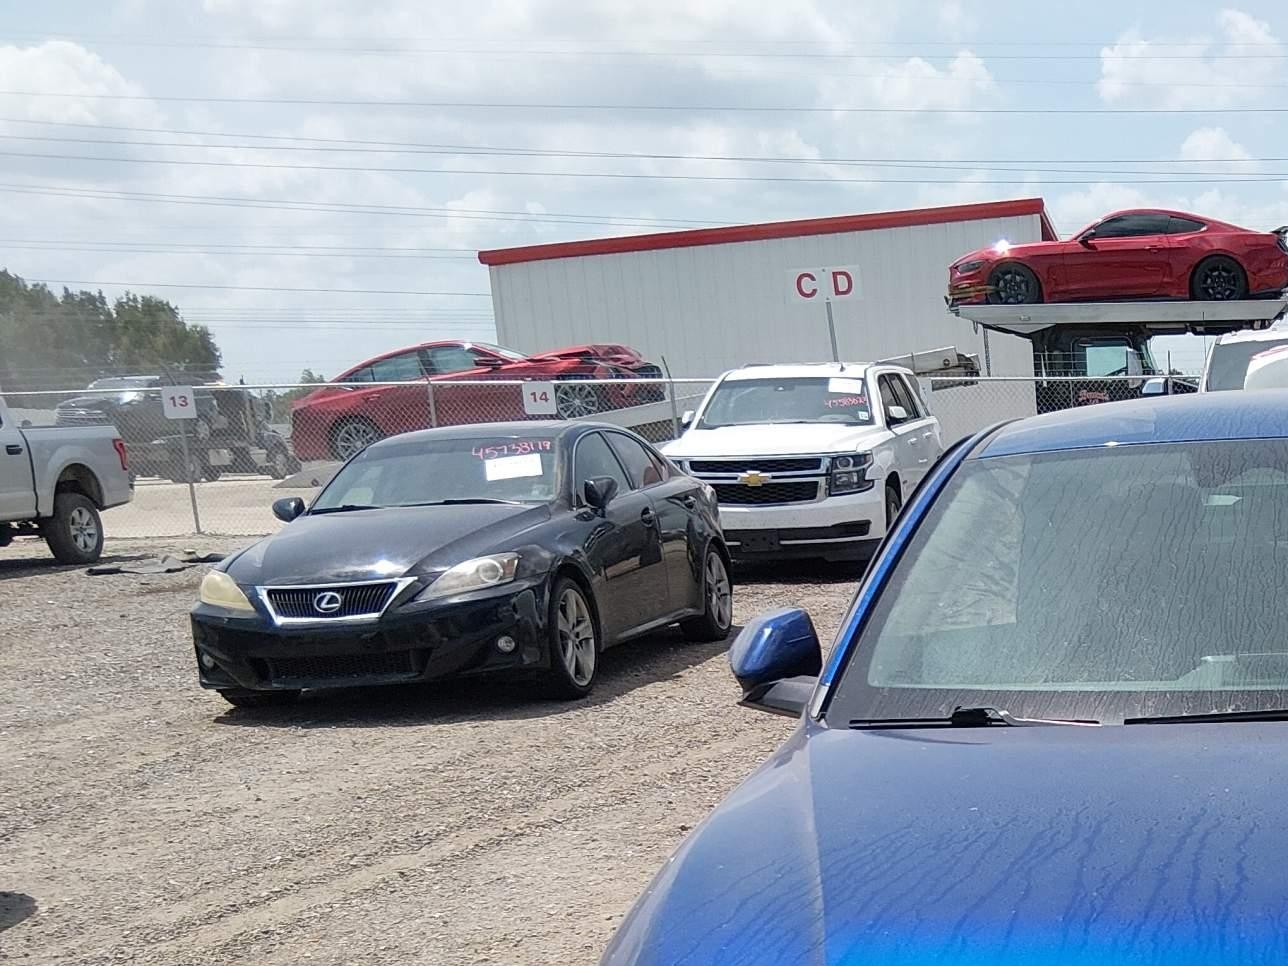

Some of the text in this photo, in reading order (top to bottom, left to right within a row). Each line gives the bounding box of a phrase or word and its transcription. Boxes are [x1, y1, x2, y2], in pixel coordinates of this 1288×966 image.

[796, 271, 853, 298] C D
[170, 395, 189, 408] 13
[530, 391, 549, 403] 14
